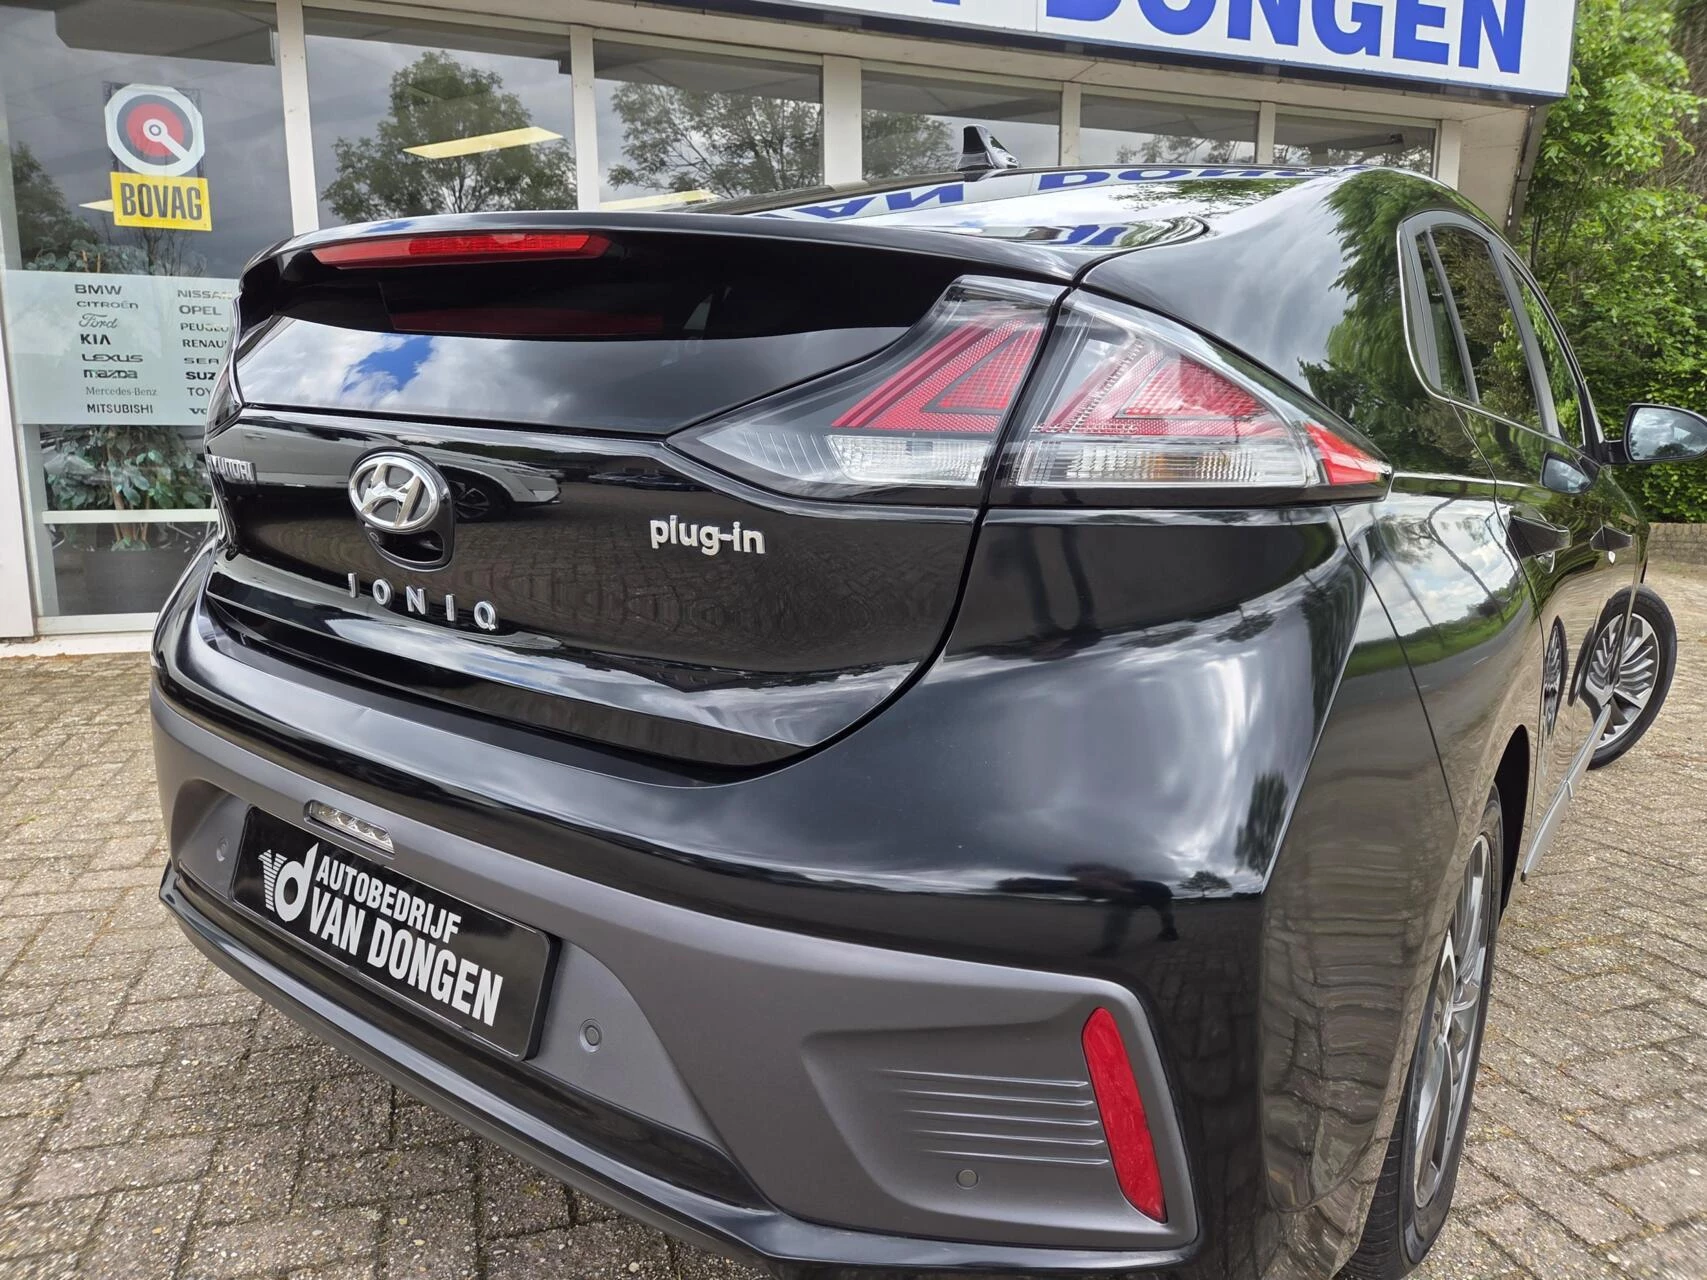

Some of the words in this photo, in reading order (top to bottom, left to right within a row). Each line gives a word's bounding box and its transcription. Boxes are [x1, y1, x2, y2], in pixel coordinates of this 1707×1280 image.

[1046, 0, 1526, 74] GEN
[120, 182, 204, 221] BOVAG
[74, 284, 122, 295] BMW
[178, 304, 222, 316] OPEL
[78, 312, 118, 329] Ford
[80, 333, 111, 345] KIA
[182, 338, 227, 349] RENAU
[81, 353, 144, 363] LEXUS
[183, 357, 220, 365] SEA
[185, 371, 217, 381] SUZ
[85, 385, 157, 397] Mercedes-Benz
[87, 403, 154, 414] MITSUBISHI
[649, 514, 766, 556] plug-in
[347, 571, 498, 632] IONIQ
[315, 855, 462, 945] AUTOBEDRIJF
[308, 886, 367, 956] VAN
[367, 920, 504, 1028] DONGEN
